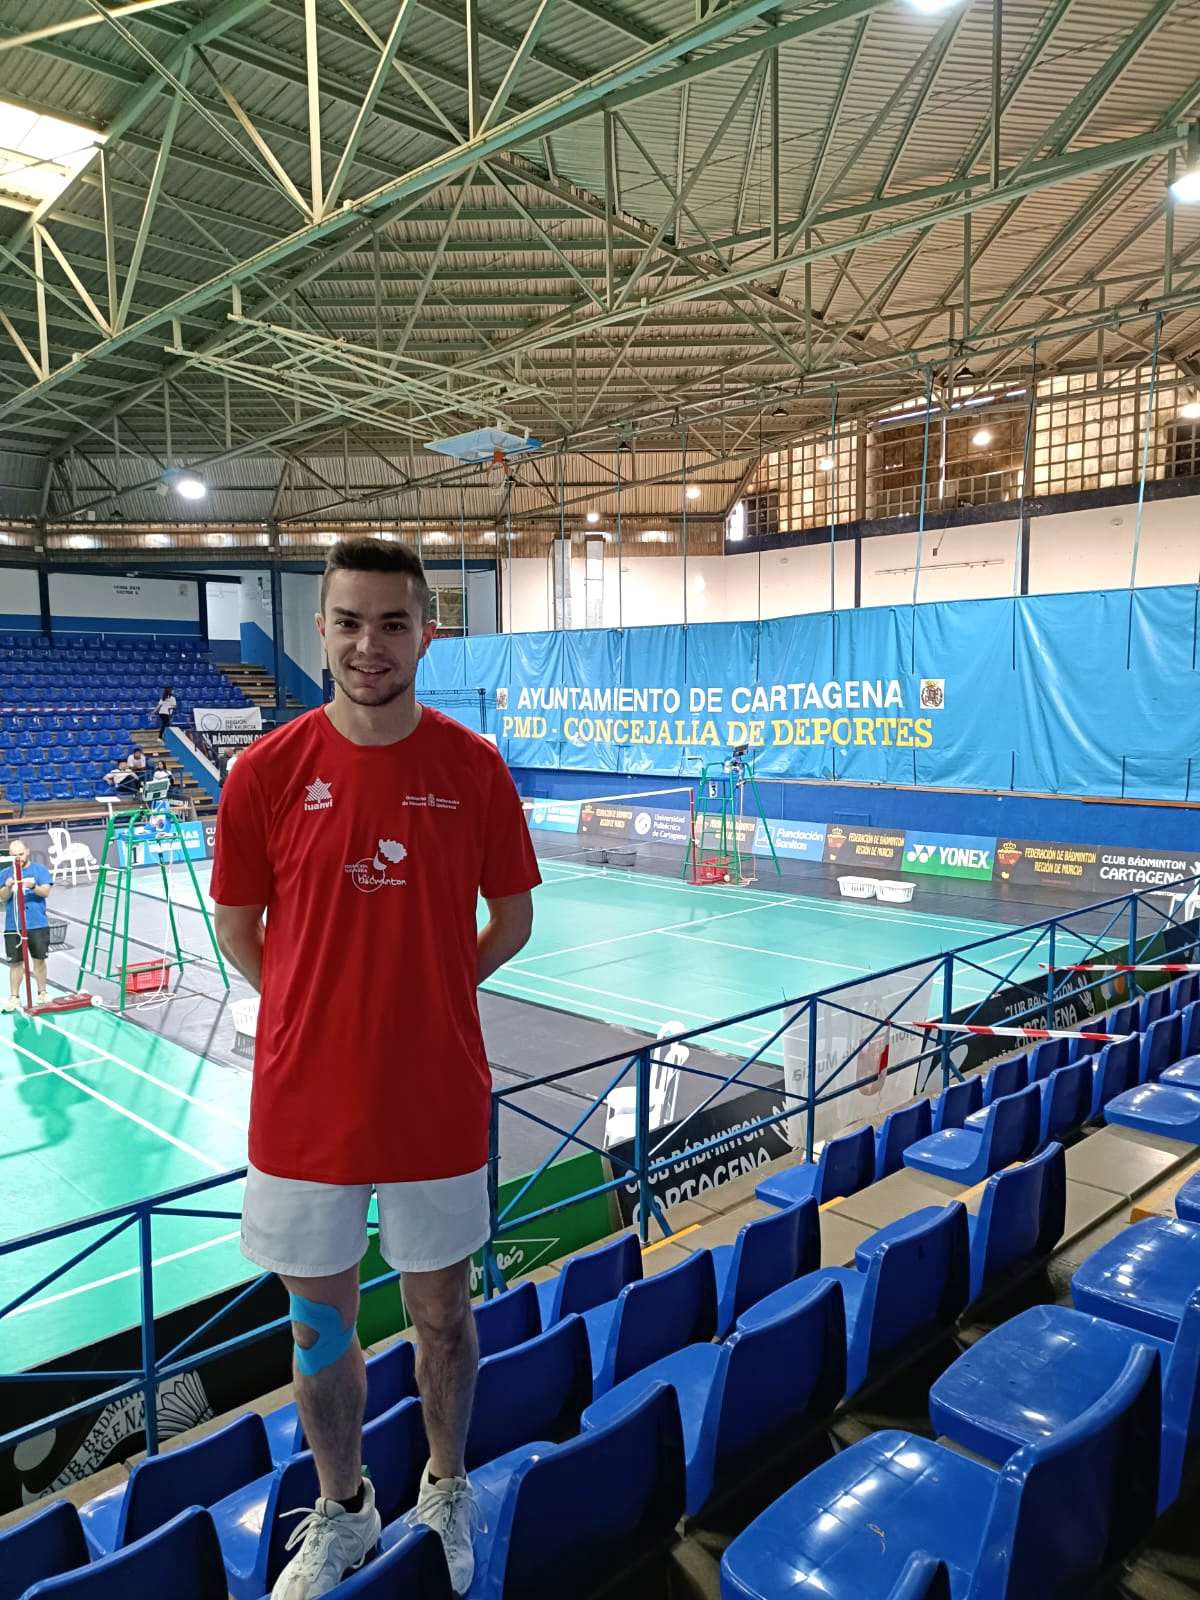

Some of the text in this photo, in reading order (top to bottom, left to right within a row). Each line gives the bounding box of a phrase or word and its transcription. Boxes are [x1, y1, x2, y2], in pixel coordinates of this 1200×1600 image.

[518, 679, 904, 714] AYUNTAMIENTO DE CARTAGENA
[502, 715, 547, 739] PMD
[727, 720, 765, 747] DE
[771, 717, 933, 748] DEPORTES
[710, 784, 717, 797] 3
[654, 813, 686, 824] Universidad
[776, 828, 824, 841] Fundación
[775, 839, 808, 850] Sanitas
[939, 846, 990, 869] YONEX
[1024, 846, 1097, 864] FEDERACIÓN DE BÁDMINTON
[1101, 855, 1187, 871] CLUB BÁDMINTON
[1034, 859, 1083, 877] REGIÓN DE MURCIA
[1100, 866, 1185, 887] CARTAGENA
